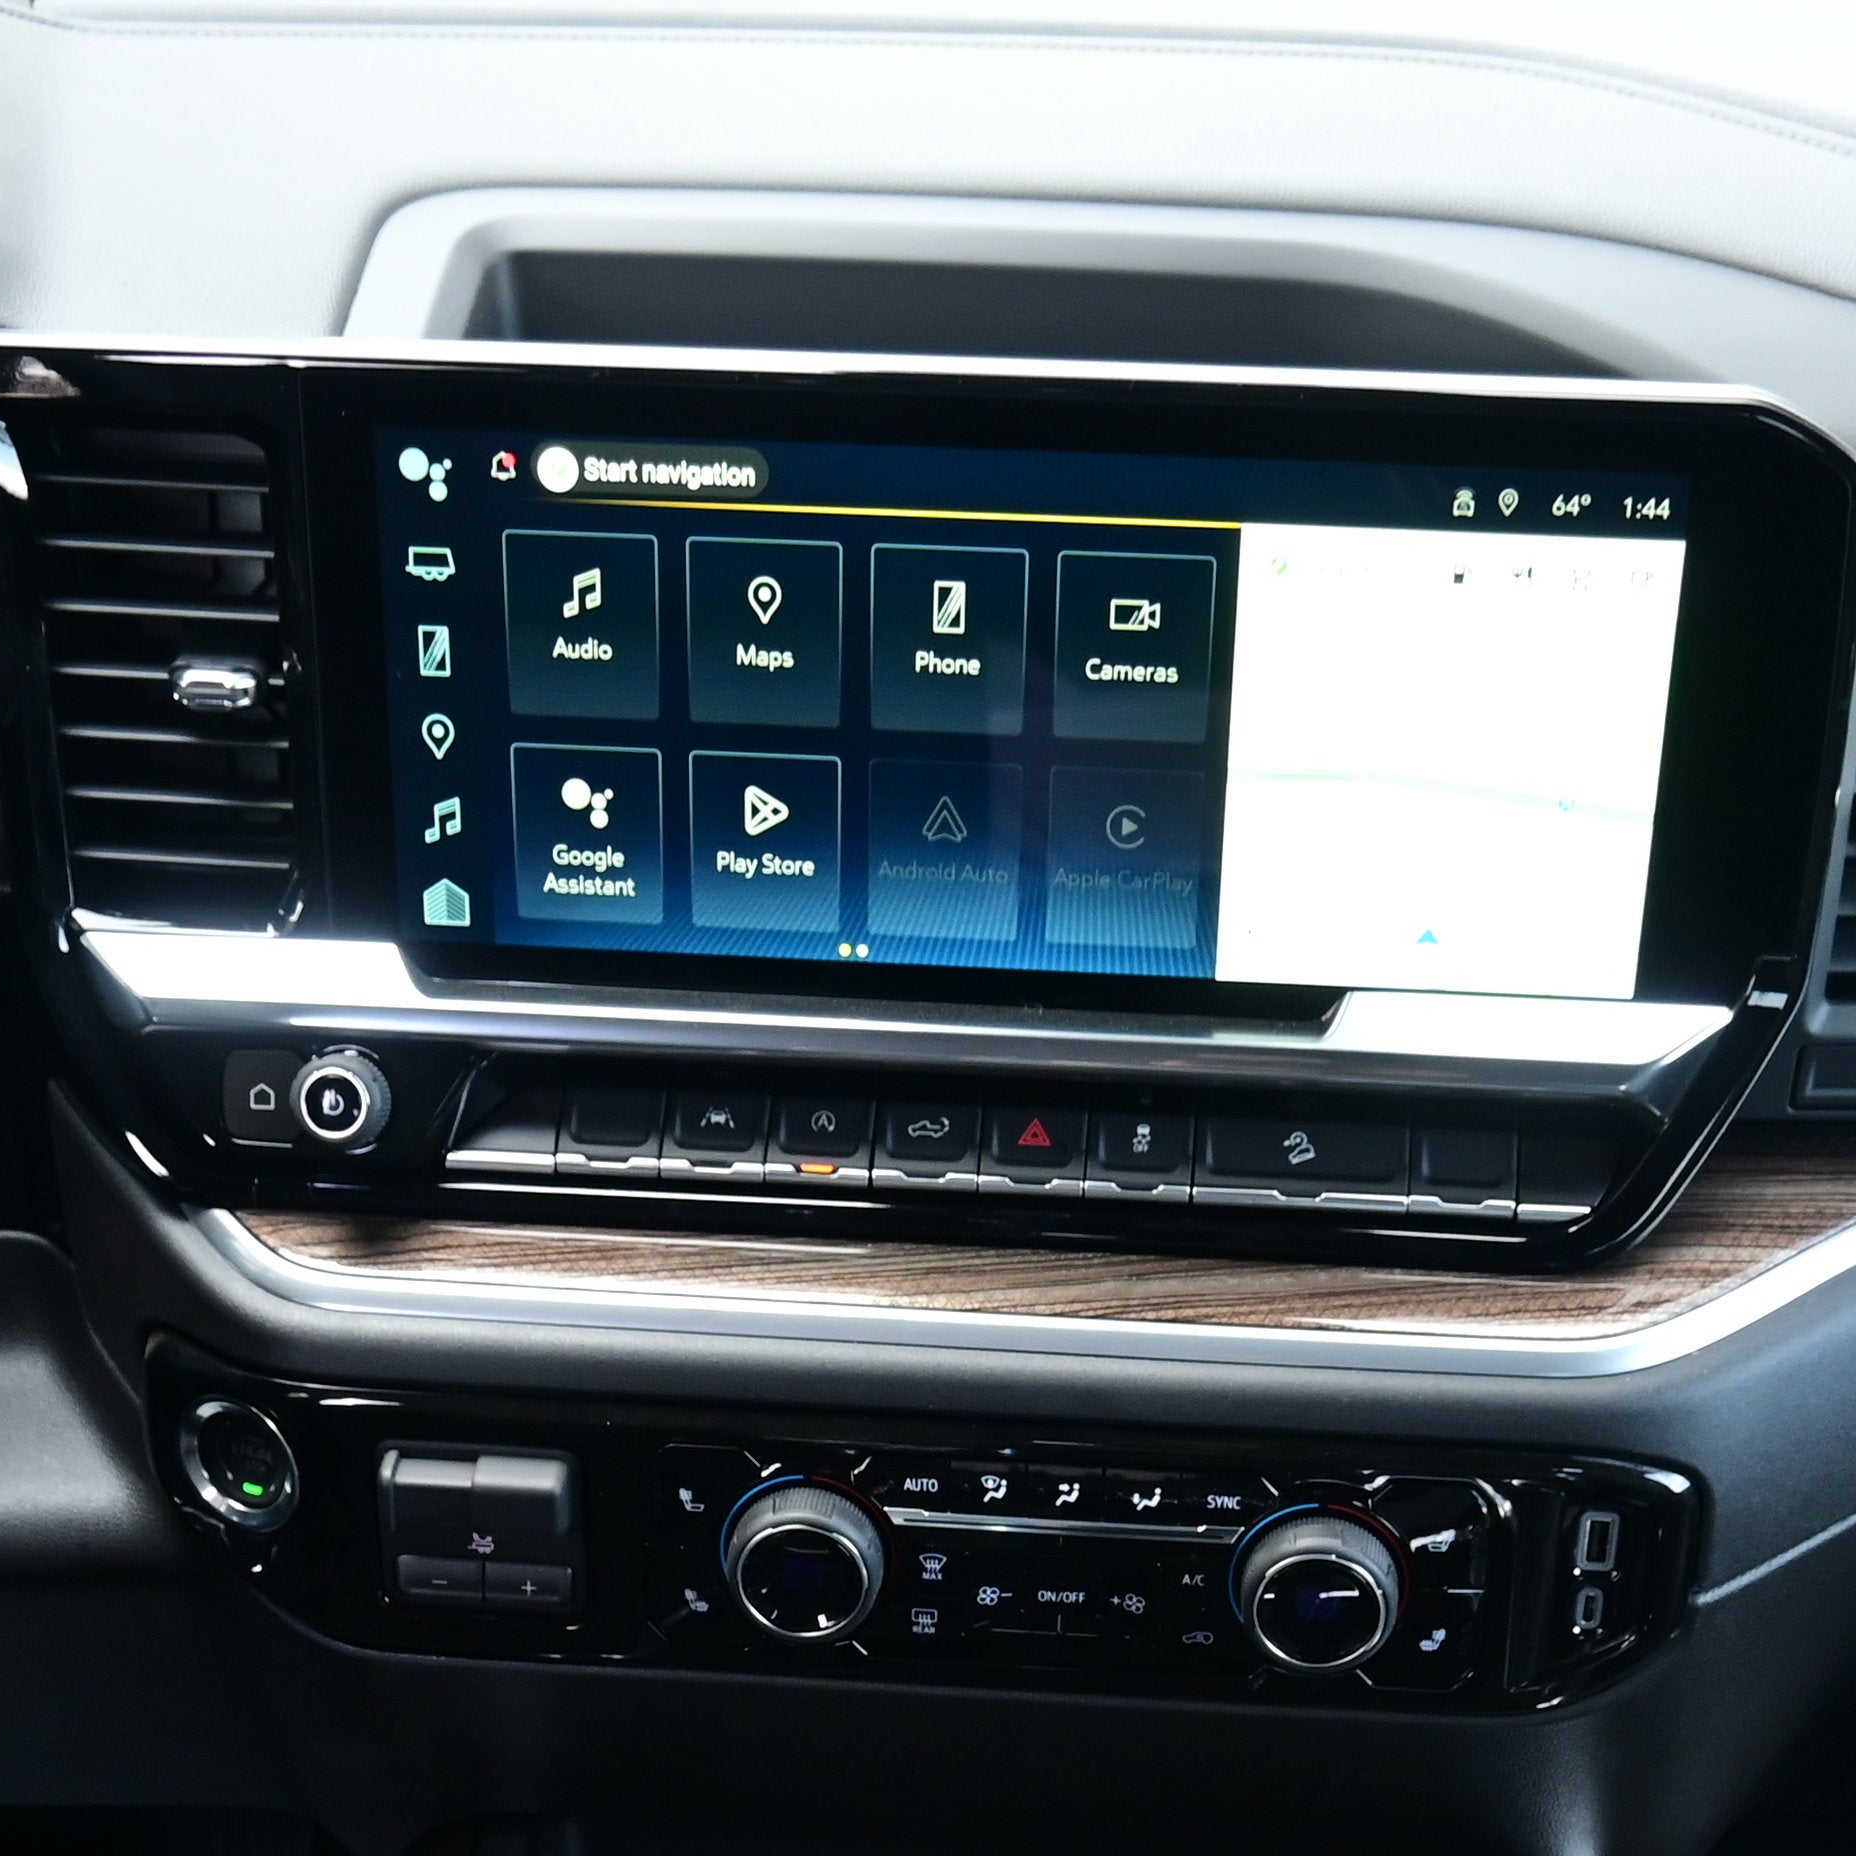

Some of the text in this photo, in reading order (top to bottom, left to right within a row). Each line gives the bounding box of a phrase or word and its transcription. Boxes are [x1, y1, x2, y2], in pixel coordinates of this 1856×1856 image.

[583, 456, 757, 492] Start navigation
[1623, 496, 1672, 521] 1:44
[551, 636, 614, 662] Audio
[736, 643, 796, 673] Maps
[914, 650, 982, 677] Phone
[1085, 657, 1180, 685] Cameras
[551, 843, 626, 874] Google
[716, 849, 816, 879] Play Store
[543, 872, 637, 898] Assistant
[877, 860, 1010, 885] Android Auto
[1053, 867, 1195, 896] Apple CarPlay
[903, 1477, 939, 1493] AUTO
[1206, 1494, 1242, 1512] SYNC
[1182, 1573, 1205, 1588] A/C
[1037, 1589, 1086, 1604] ON/OFF
